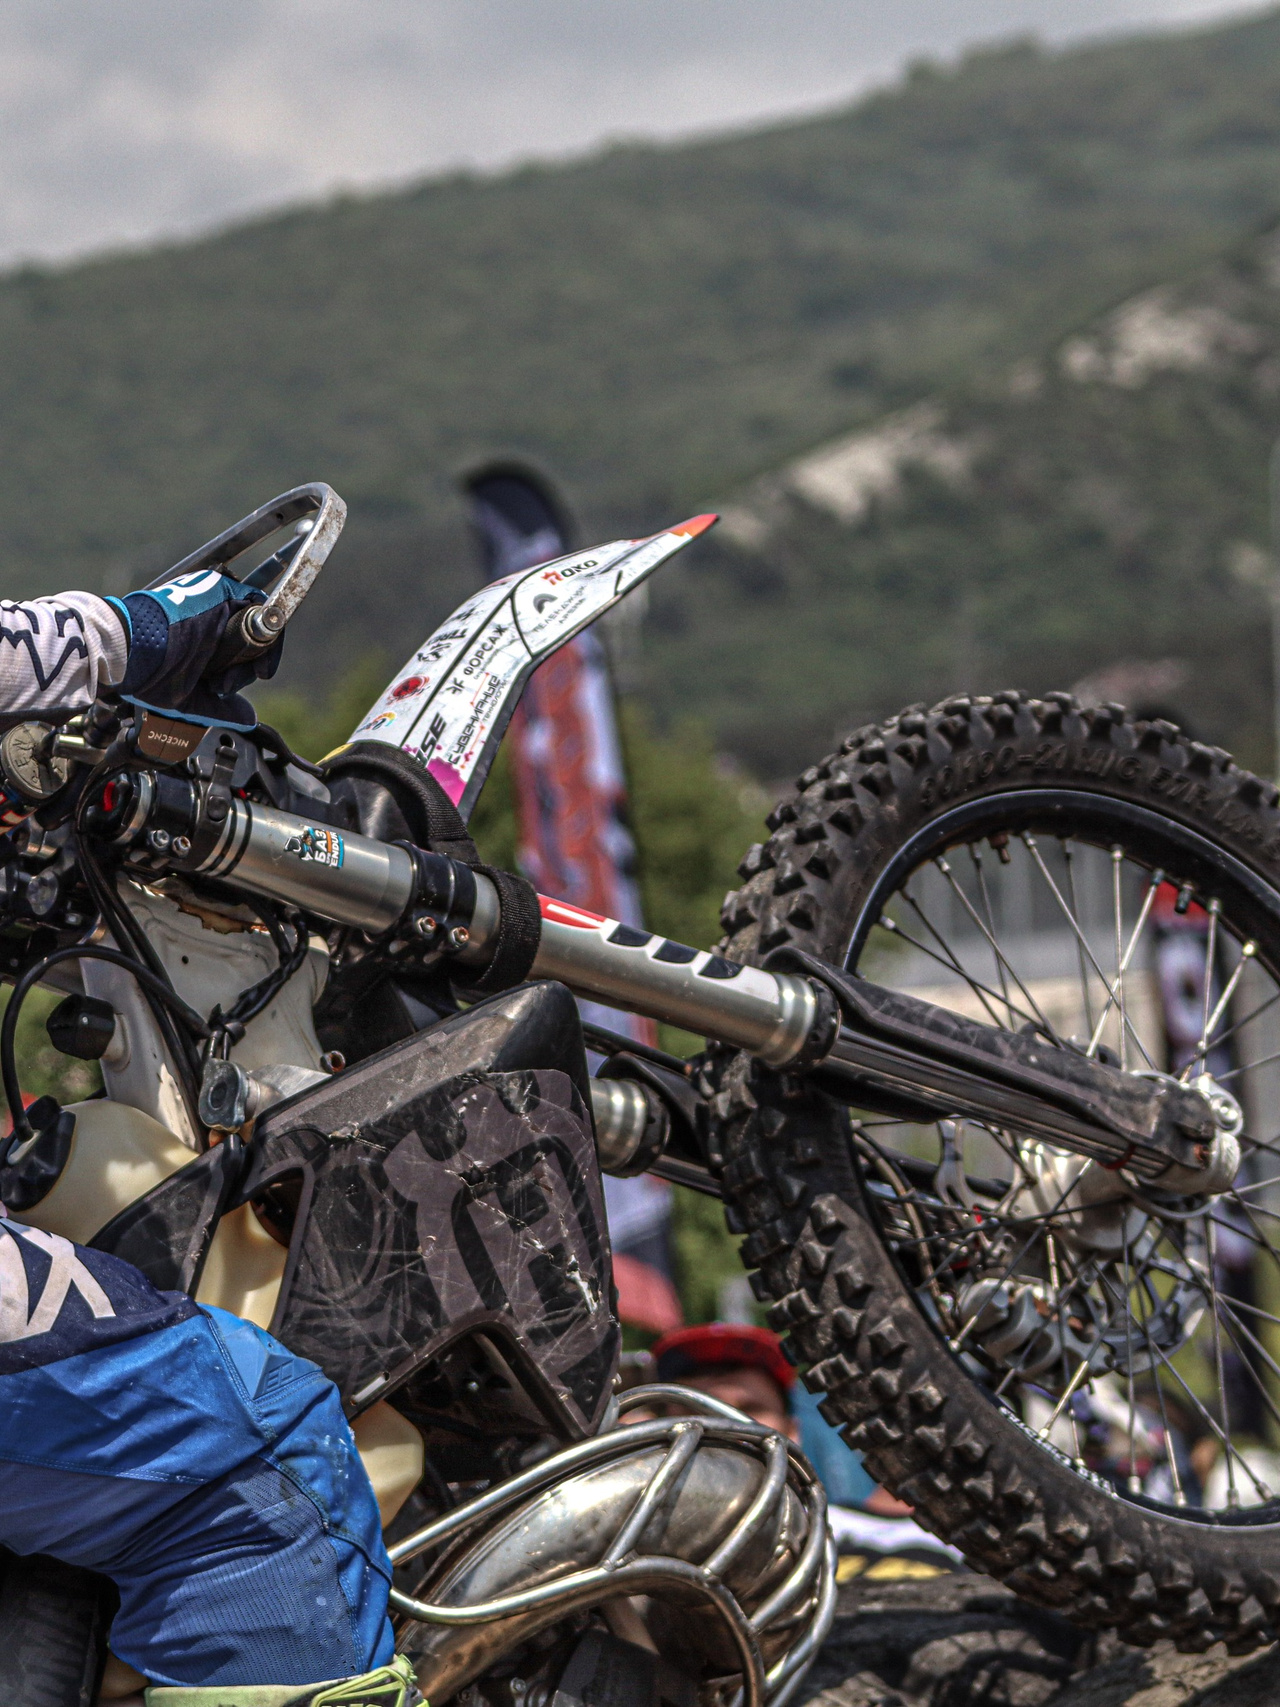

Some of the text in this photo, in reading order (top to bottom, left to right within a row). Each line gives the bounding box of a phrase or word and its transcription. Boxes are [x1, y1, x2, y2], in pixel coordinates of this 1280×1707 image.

[463, 624, 509, 676] ФОРСАЖ
[147, 730, 190, 748] NICECNC
[314, 828, 328, 864] БАЗ
[329, 831, 340, 867] ENDUR
